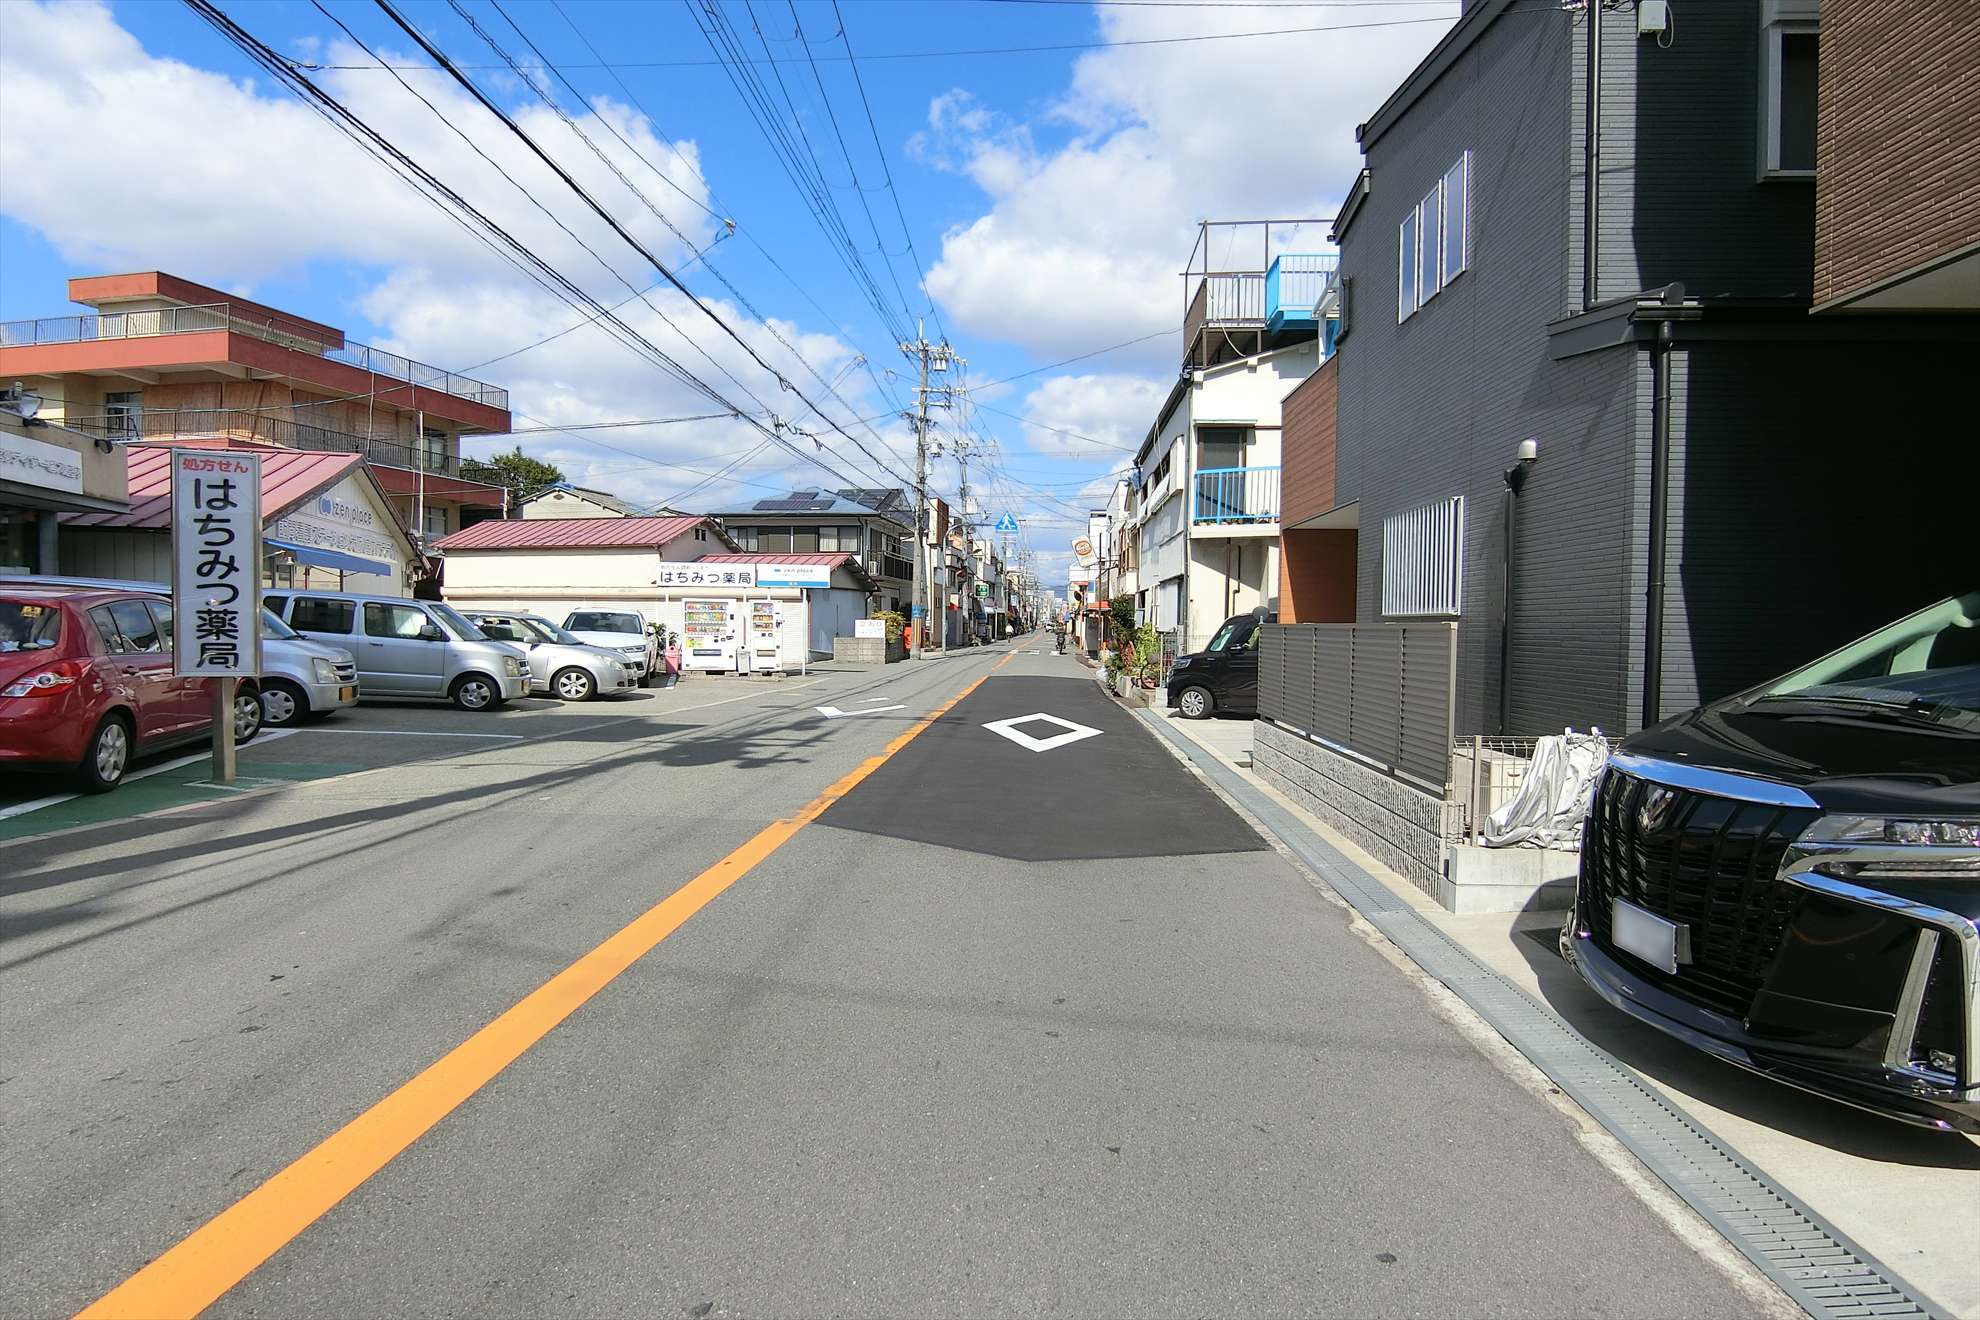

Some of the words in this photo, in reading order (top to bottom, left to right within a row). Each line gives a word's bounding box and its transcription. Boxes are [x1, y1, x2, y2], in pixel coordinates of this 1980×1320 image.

[182, 458, 249, 474] 処方せん
[334, 502, 350, 519] zen
[351, 504, 373, 526] place
[193, 477, 240, 669] はちみつ薬局
[659, 571, 752, 585] はちみつ薬局
